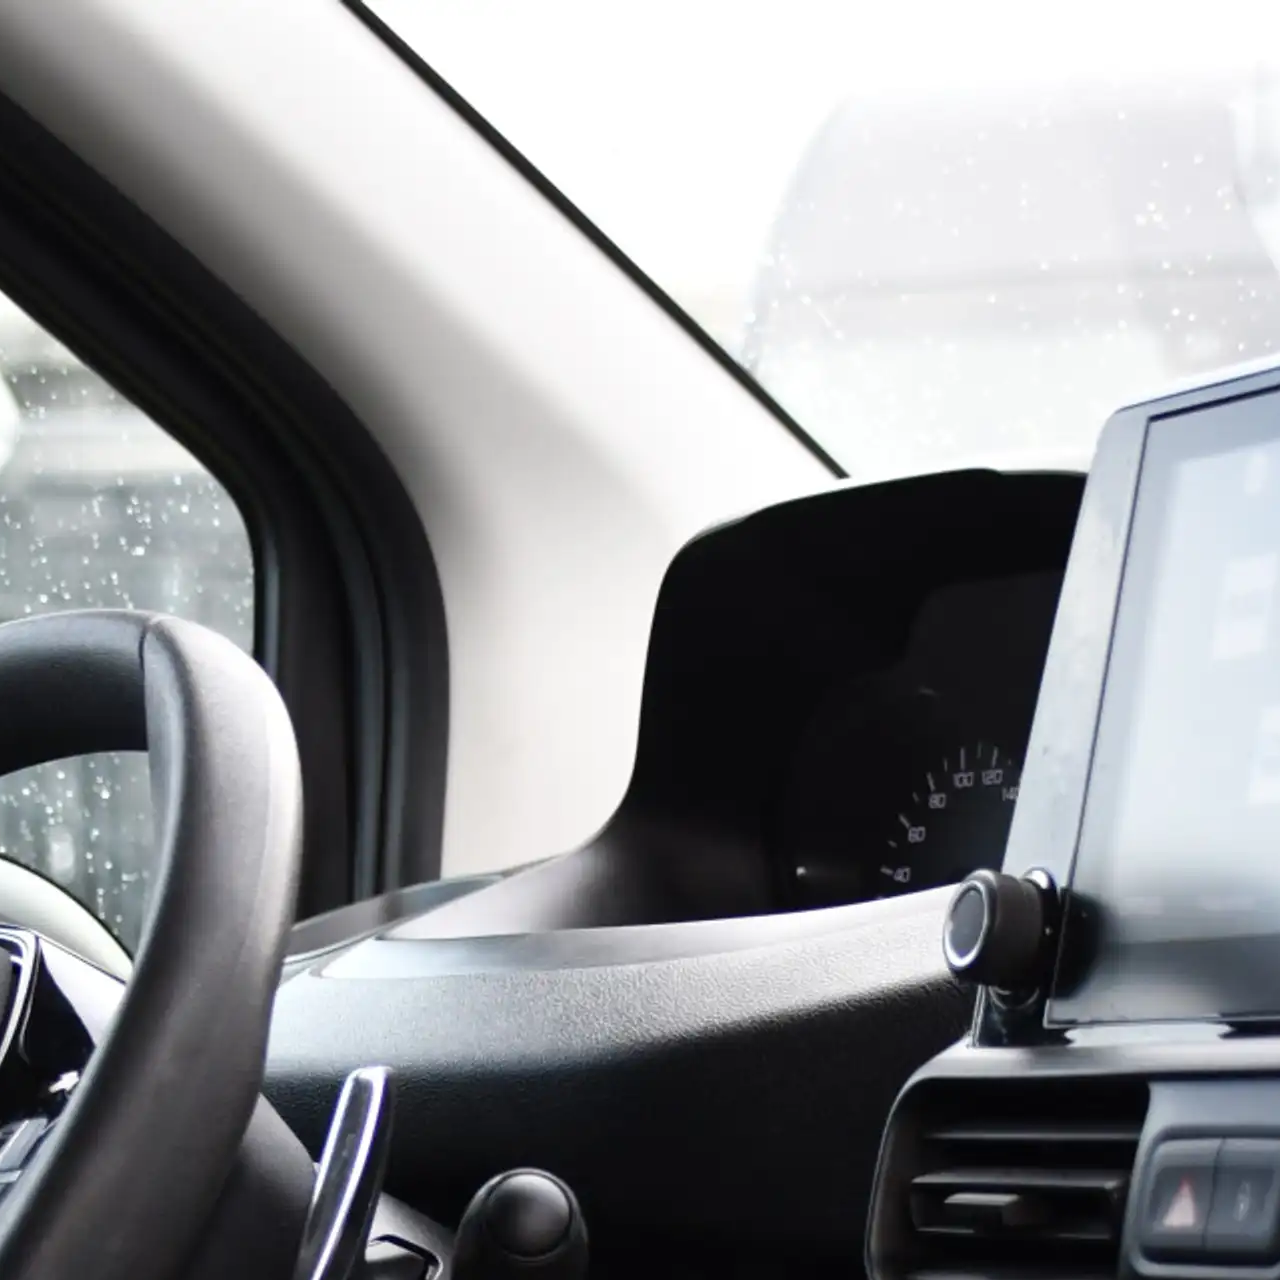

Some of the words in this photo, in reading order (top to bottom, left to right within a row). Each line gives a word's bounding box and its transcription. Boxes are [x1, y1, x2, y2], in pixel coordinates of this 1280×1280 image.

[953, 771, 974, 788] 100
[981, 769, 1003, 785] 120
[928, 793, 946, 809] 80
[908, 826, 926, 843] 60
[894, 867, 911, 883] 40
